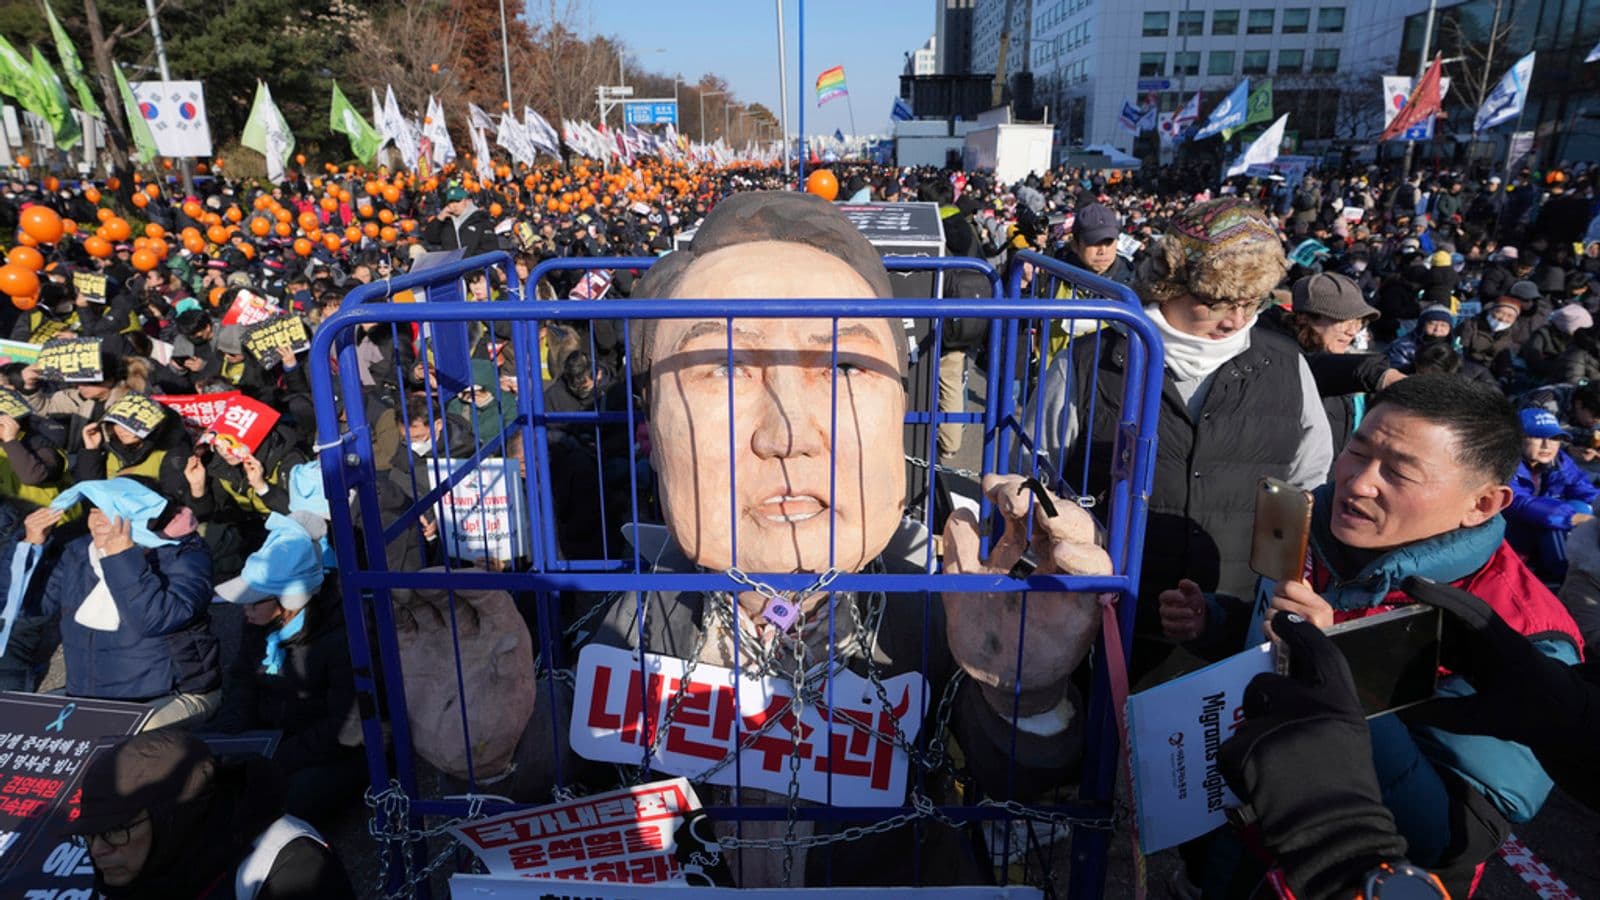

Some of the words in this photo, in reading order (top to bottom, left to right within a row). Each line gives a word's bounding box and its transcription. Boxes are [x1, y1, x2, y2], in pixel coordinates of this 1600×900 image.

[224, 405, 259, 438] 핵
[587, 666, 896, 790] 내란수괴
[1199, 691, 1226, 761] Migrants
[508, 825, 663, 870] 윤석열을
